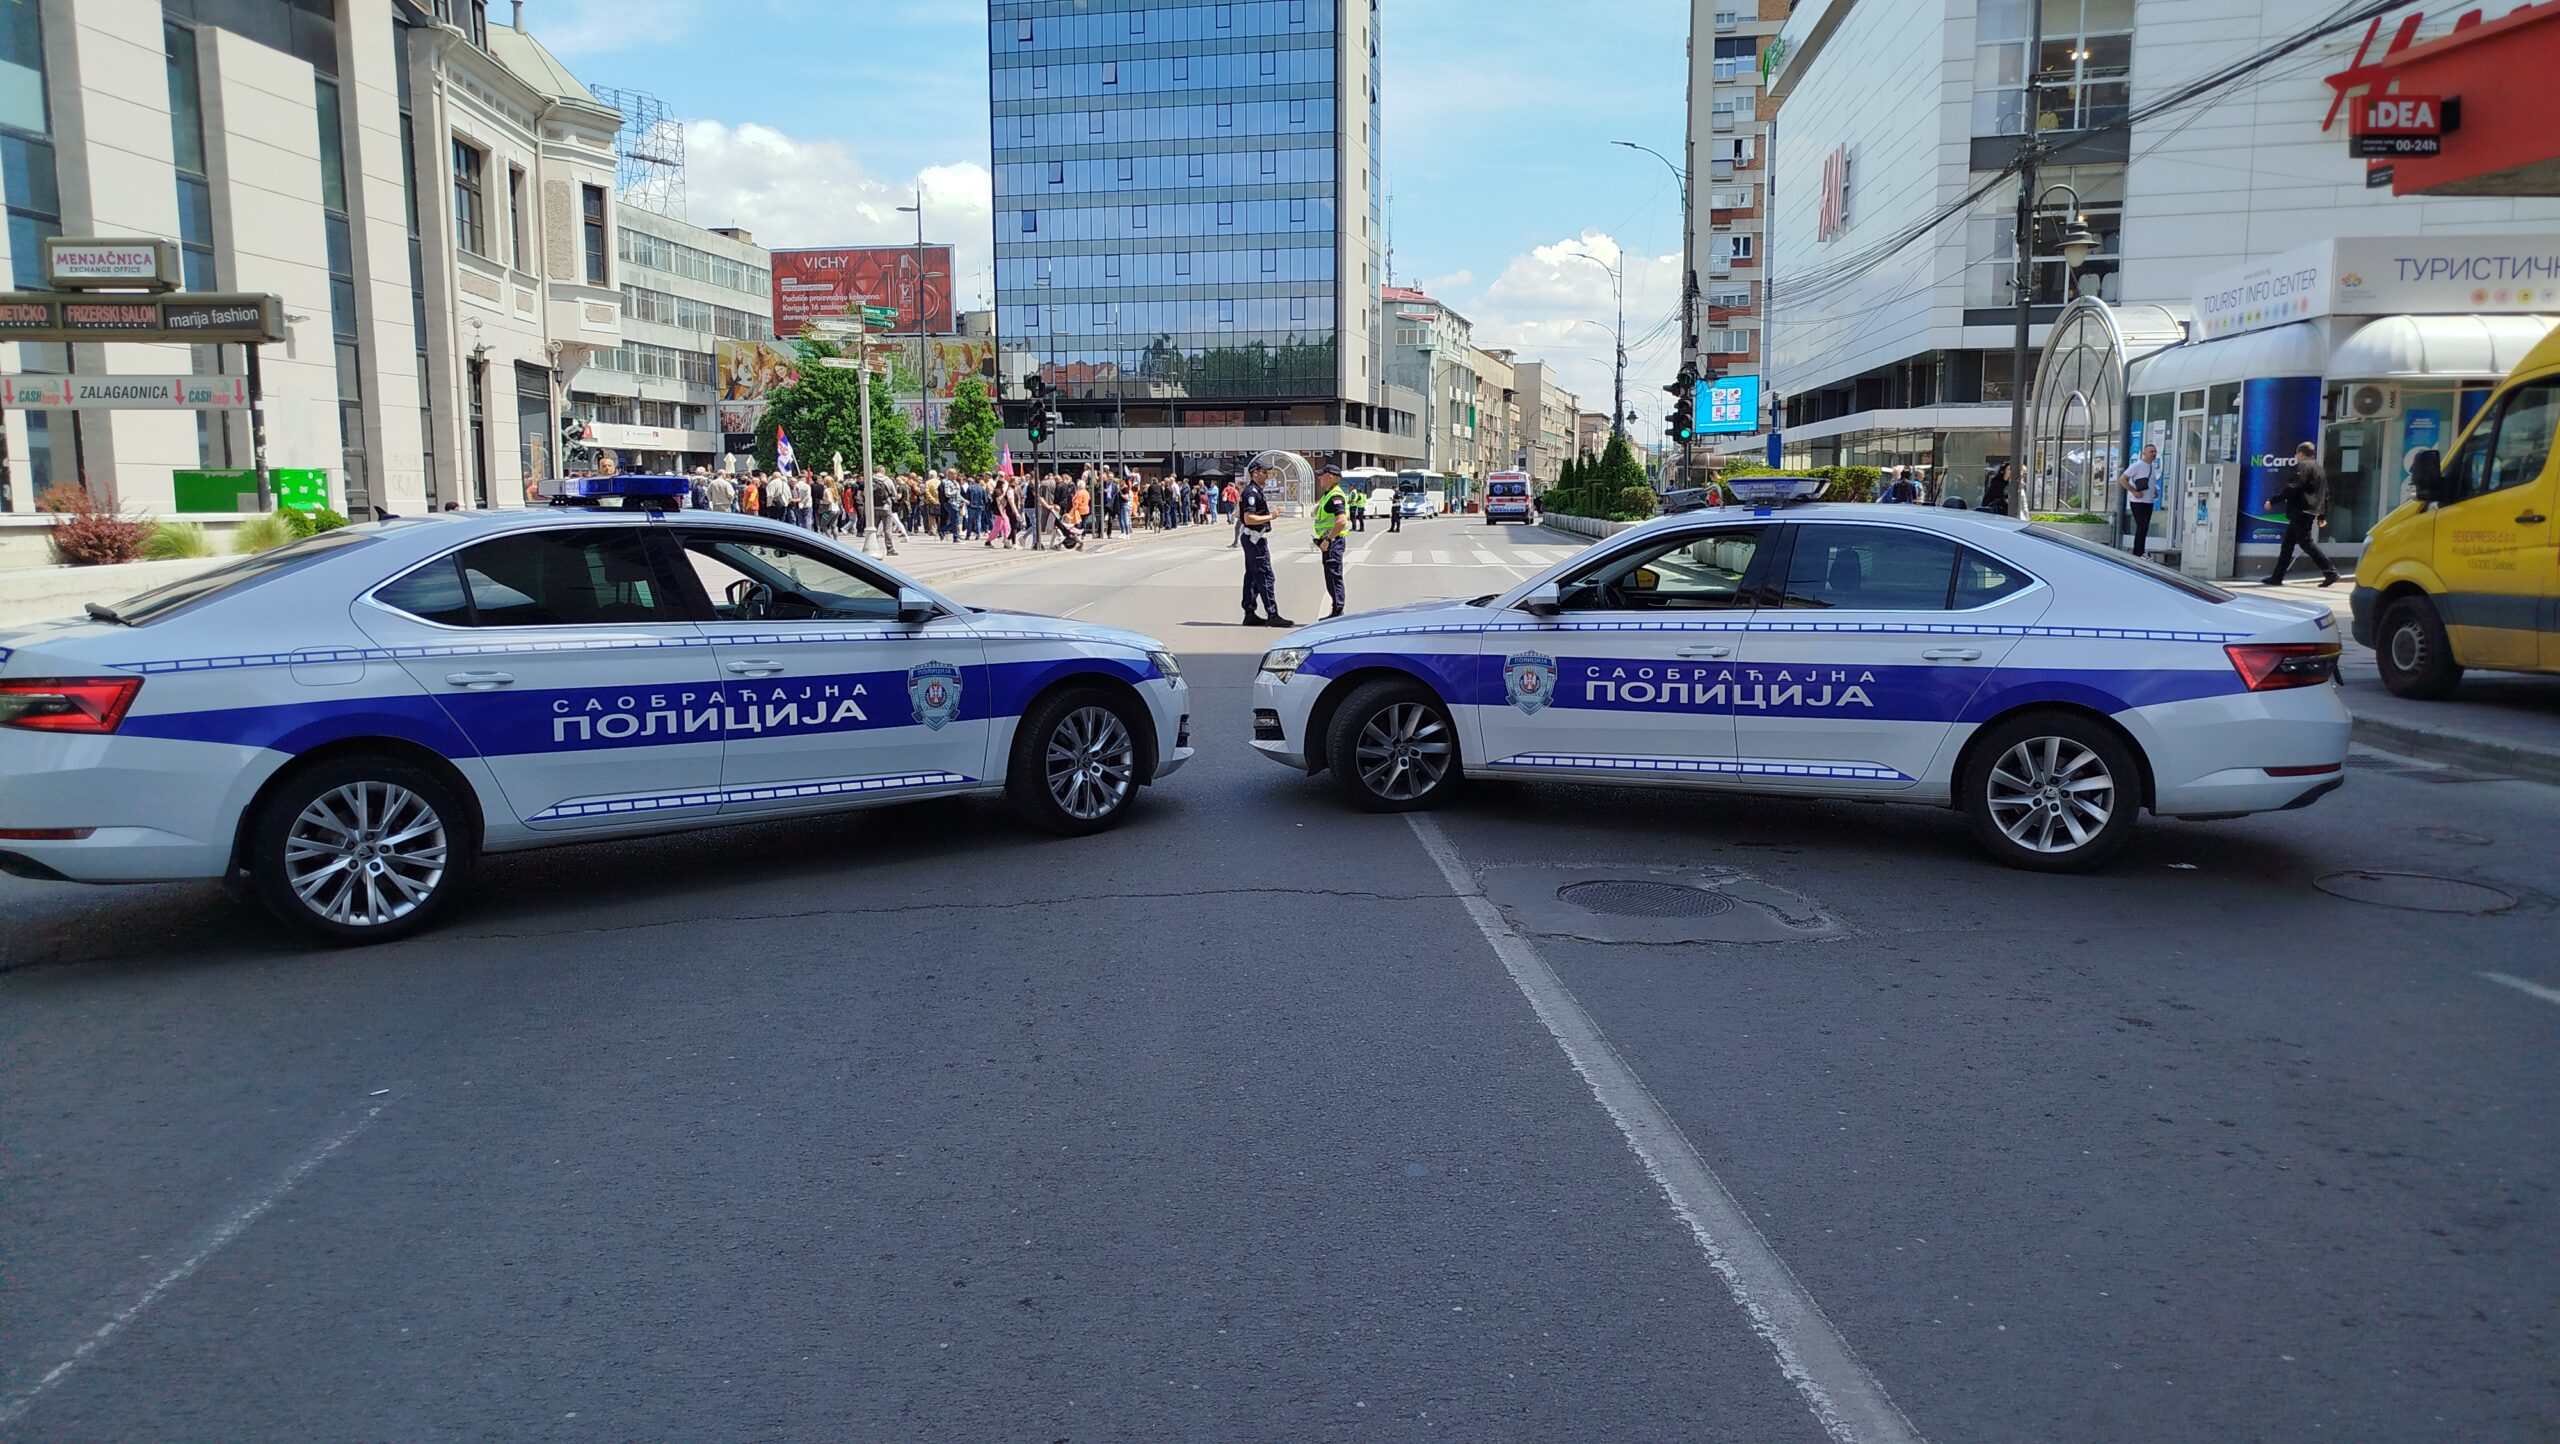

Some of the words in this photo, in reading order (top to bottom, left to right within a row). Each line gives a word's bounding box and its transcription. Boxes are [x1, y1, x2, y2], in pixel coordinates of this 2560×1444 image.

[2395, 140, 2437, 151] 00-24h
[56, 251, 152, 265] MENJAČNICA
[803, 256, 849, 269] VICHY
[2204, 287, 2244, 314] TOURIST
[2246, 280, 2270, 303] INFO
[2272, 268, 2317, 297] CENTER
[67, 305, 120, 322] FRIZERSKI
[121, 305, 156, 322] SALON
[169, 311, 209, 328] marija
[211, 307, 259, 323] fashion
[19, 390, 42, 403] CASH
[80, 386, 168, 399] ZALAGAONICA
[188, 390, 211, 403] CASH
[1181, 451, 1233, 459] HOTEL
[917, 668, 952, 676] ПОЛИЦИЈА
[1586, 666, 1876, 682] САОБРАЋАЈНА
[553, 684, 868, 713] САОБРАЋАЈНА
[1586, 681, 1875, 709] ПОЛИЦИЈА
[553, 699, 868, 742] ПОЛИЦИЈА
